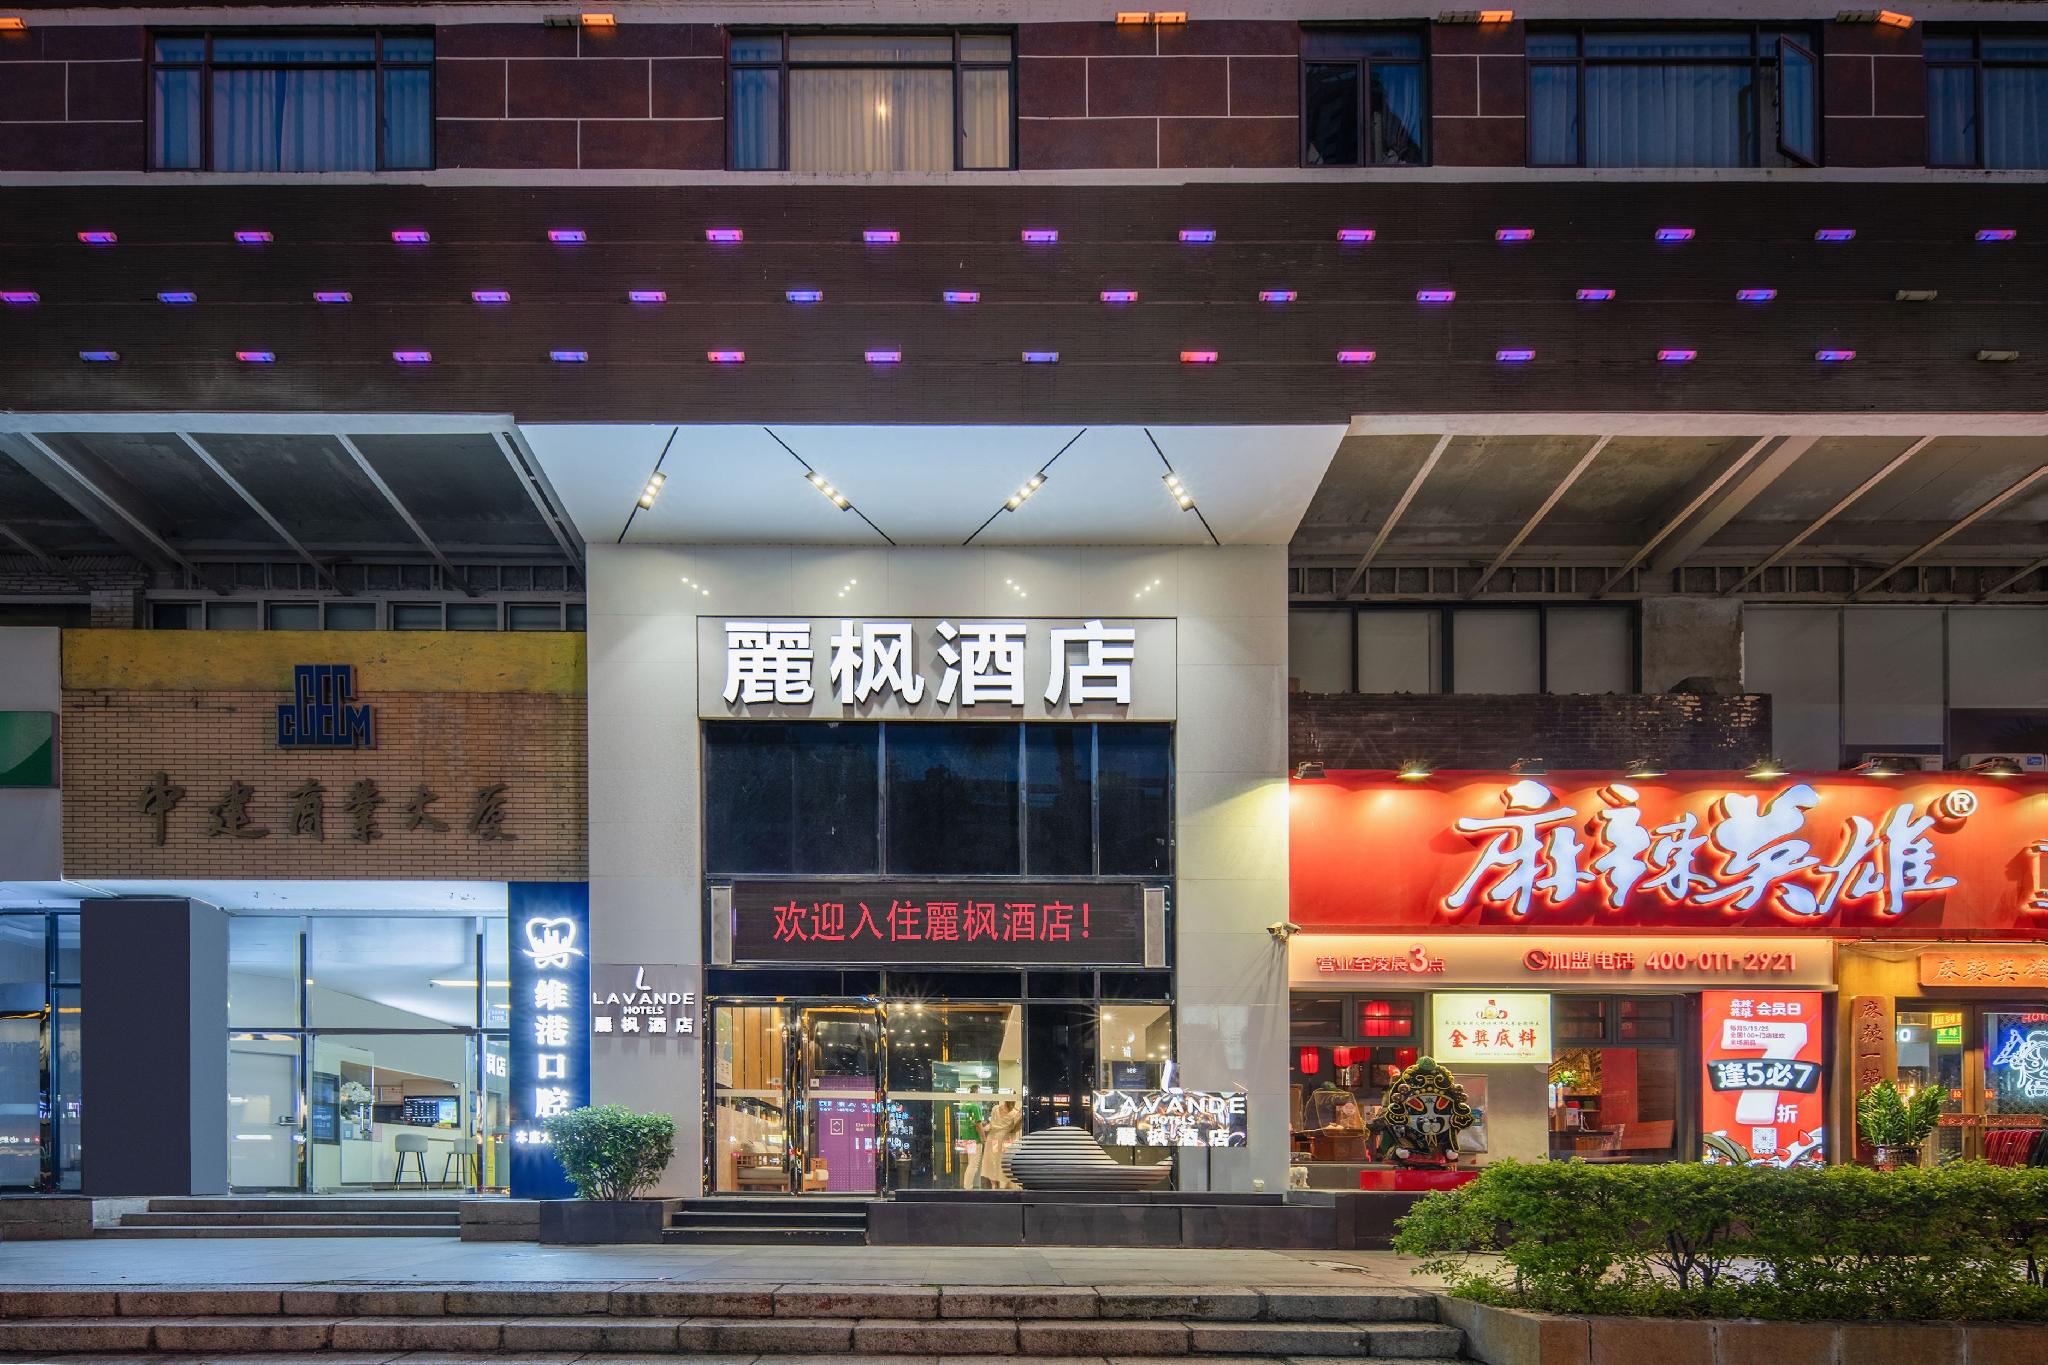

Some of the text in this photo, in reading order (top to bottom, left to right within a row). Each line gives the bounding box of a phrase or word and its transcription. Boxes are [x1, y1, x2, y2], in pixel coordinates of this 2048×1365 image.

[723, 620, 1135, 705] 麗枫酒店
[1317, 944, 1445, 973] 营业至凌晨3点
[1549, 951, 1797, 971] 加盟电话 400-011-2921
[593, 992, 695, 1005] LAVANDE
[623, 1006, 664, 1015] HOTELS
[1757, 1002, 1801, 1016] 会员日
[534, 980, 569, 1117] 维港口腔
[1717, 1062, 1812, 1089] 逢5必7
[1099, 1096, 1245, 1113] LAVANDE
[1776, 1104, 1798, 1123] 折
[1150, 1116, 1195, 1125] HOTELS
